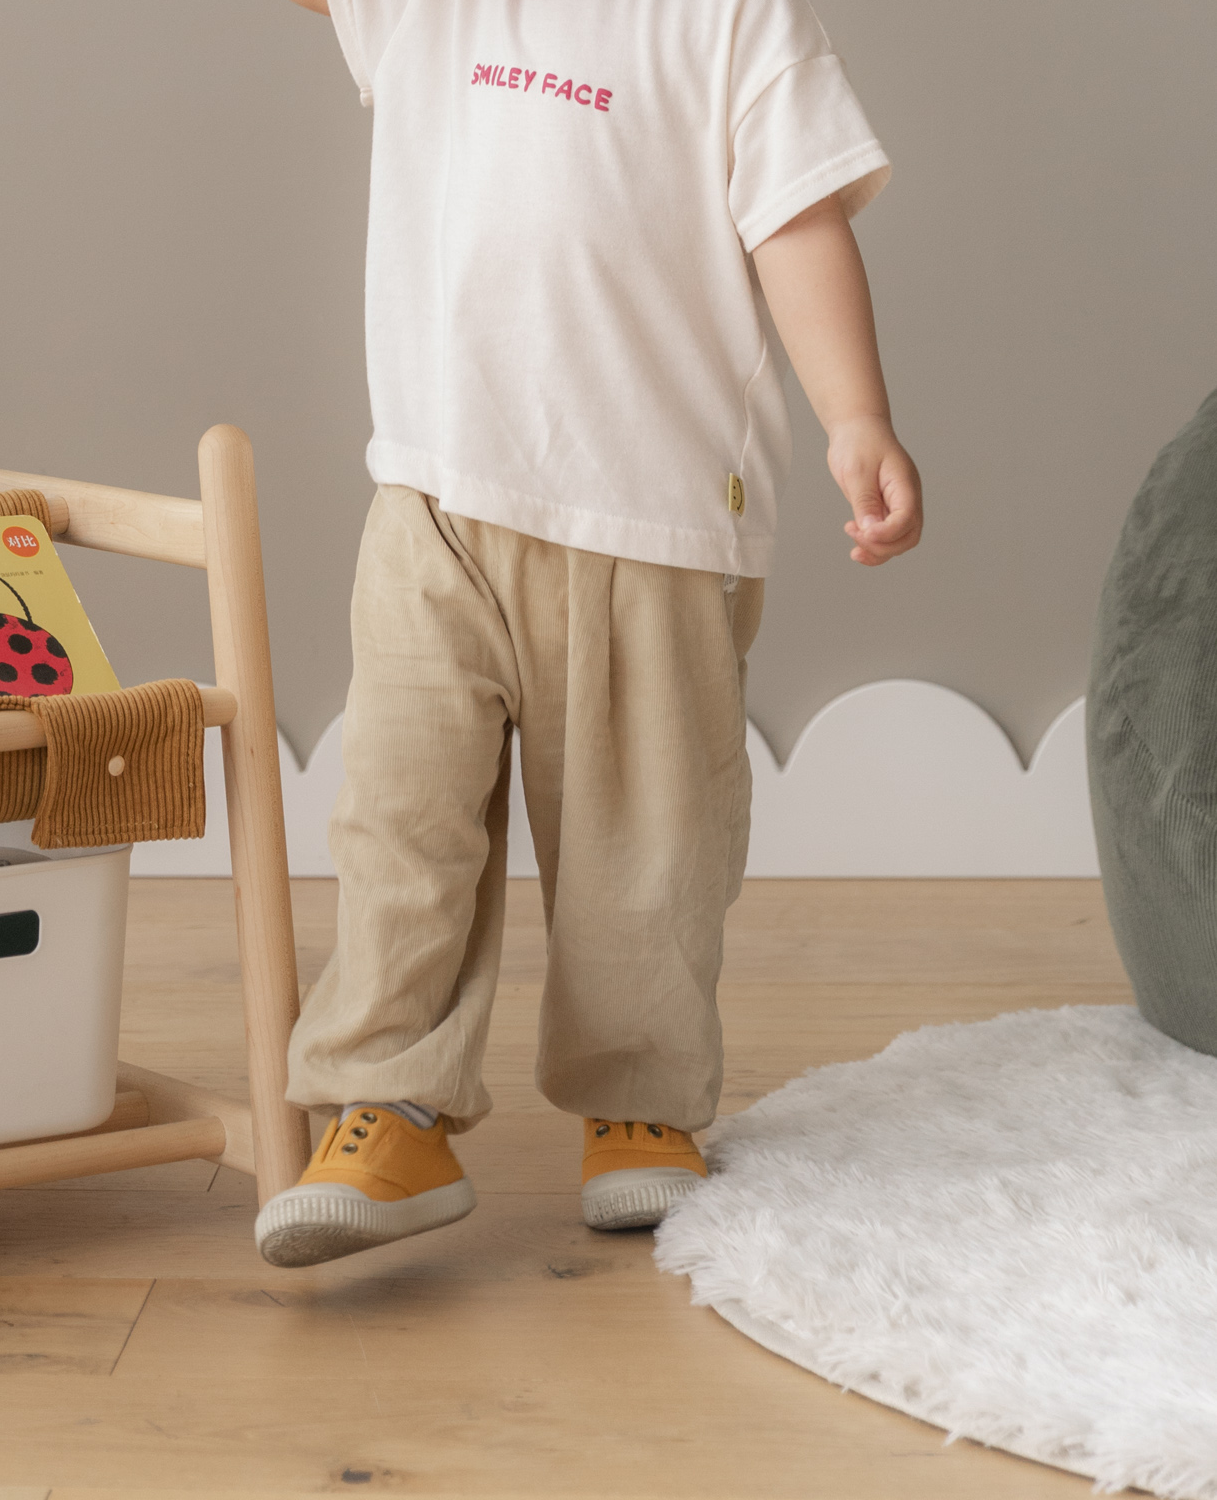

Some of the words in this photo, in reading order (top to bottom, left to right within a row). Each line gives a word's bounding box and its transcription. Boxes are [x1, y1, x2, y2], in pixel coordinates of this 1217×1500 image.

[471, 63, 537, 92] SMILEY
[542, 72, 613, 112] FACE
[7, 535, 37, 548] 对比
